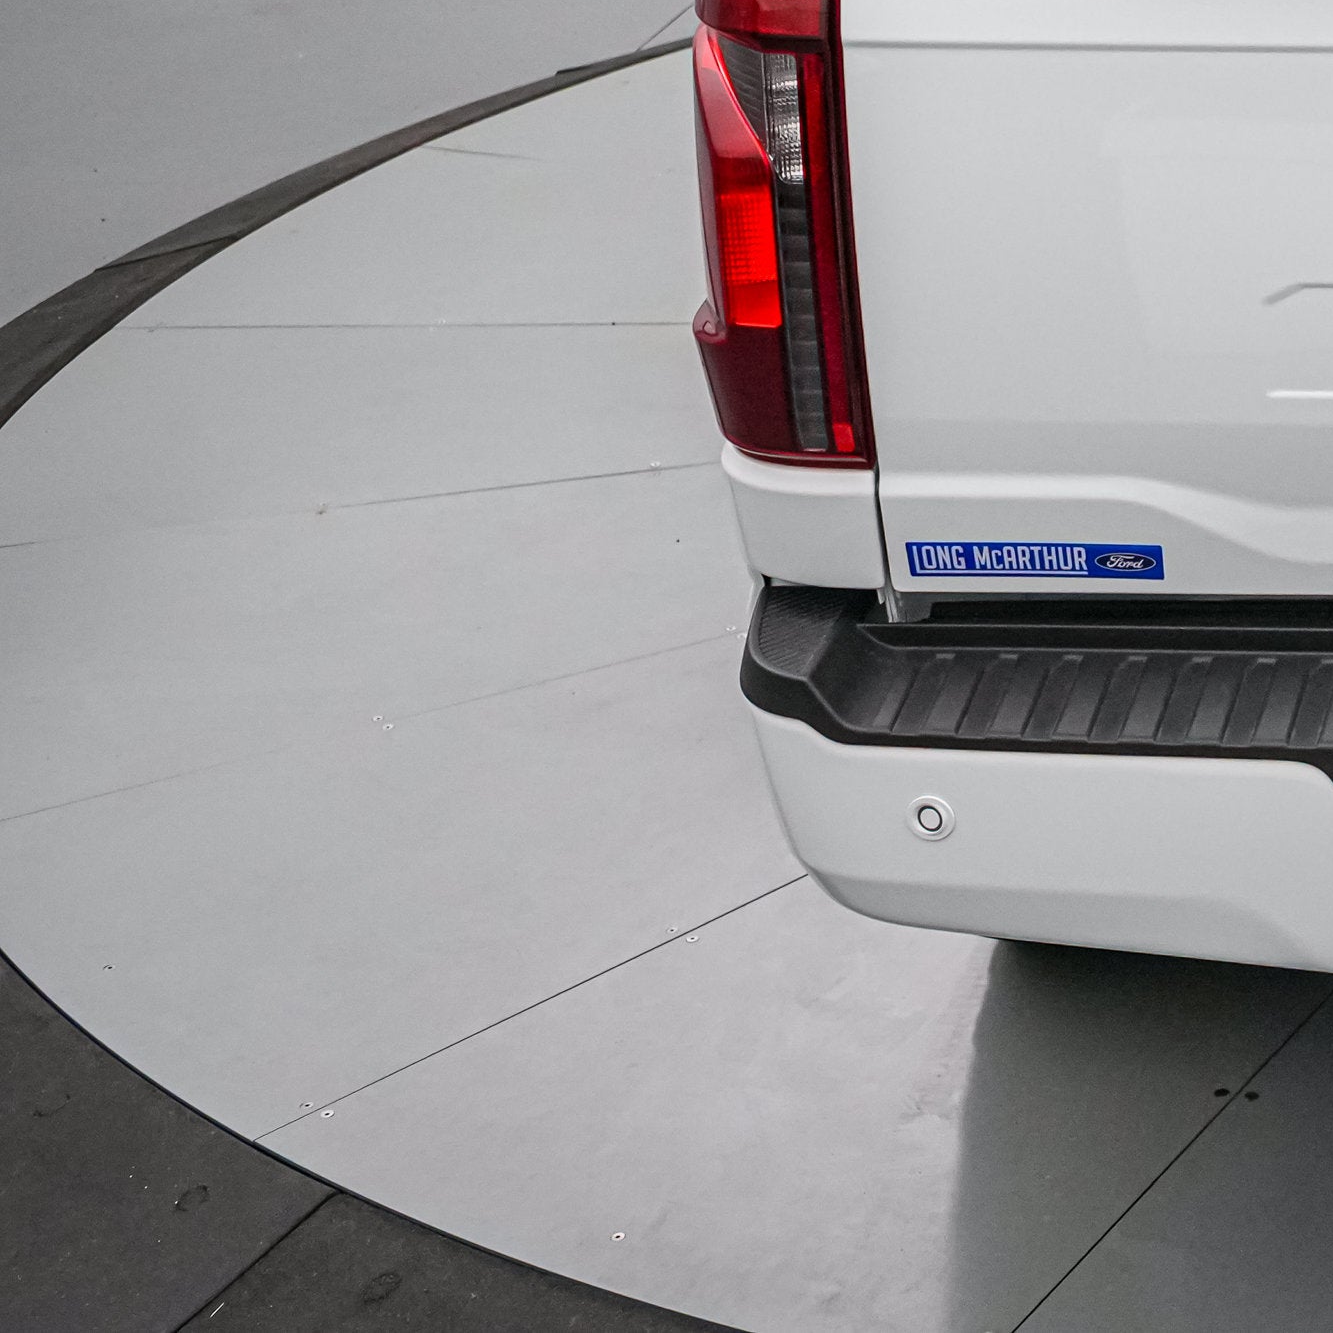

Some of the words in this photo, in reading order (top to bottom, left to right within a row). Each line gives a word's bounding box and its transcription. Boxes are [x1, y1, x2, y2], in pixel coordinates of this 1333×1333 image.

[912, 545, 966, 573] LONG
[972, 545, 1088, 571] McARTHUR
[1105, 554, 1145, 570] Ford
